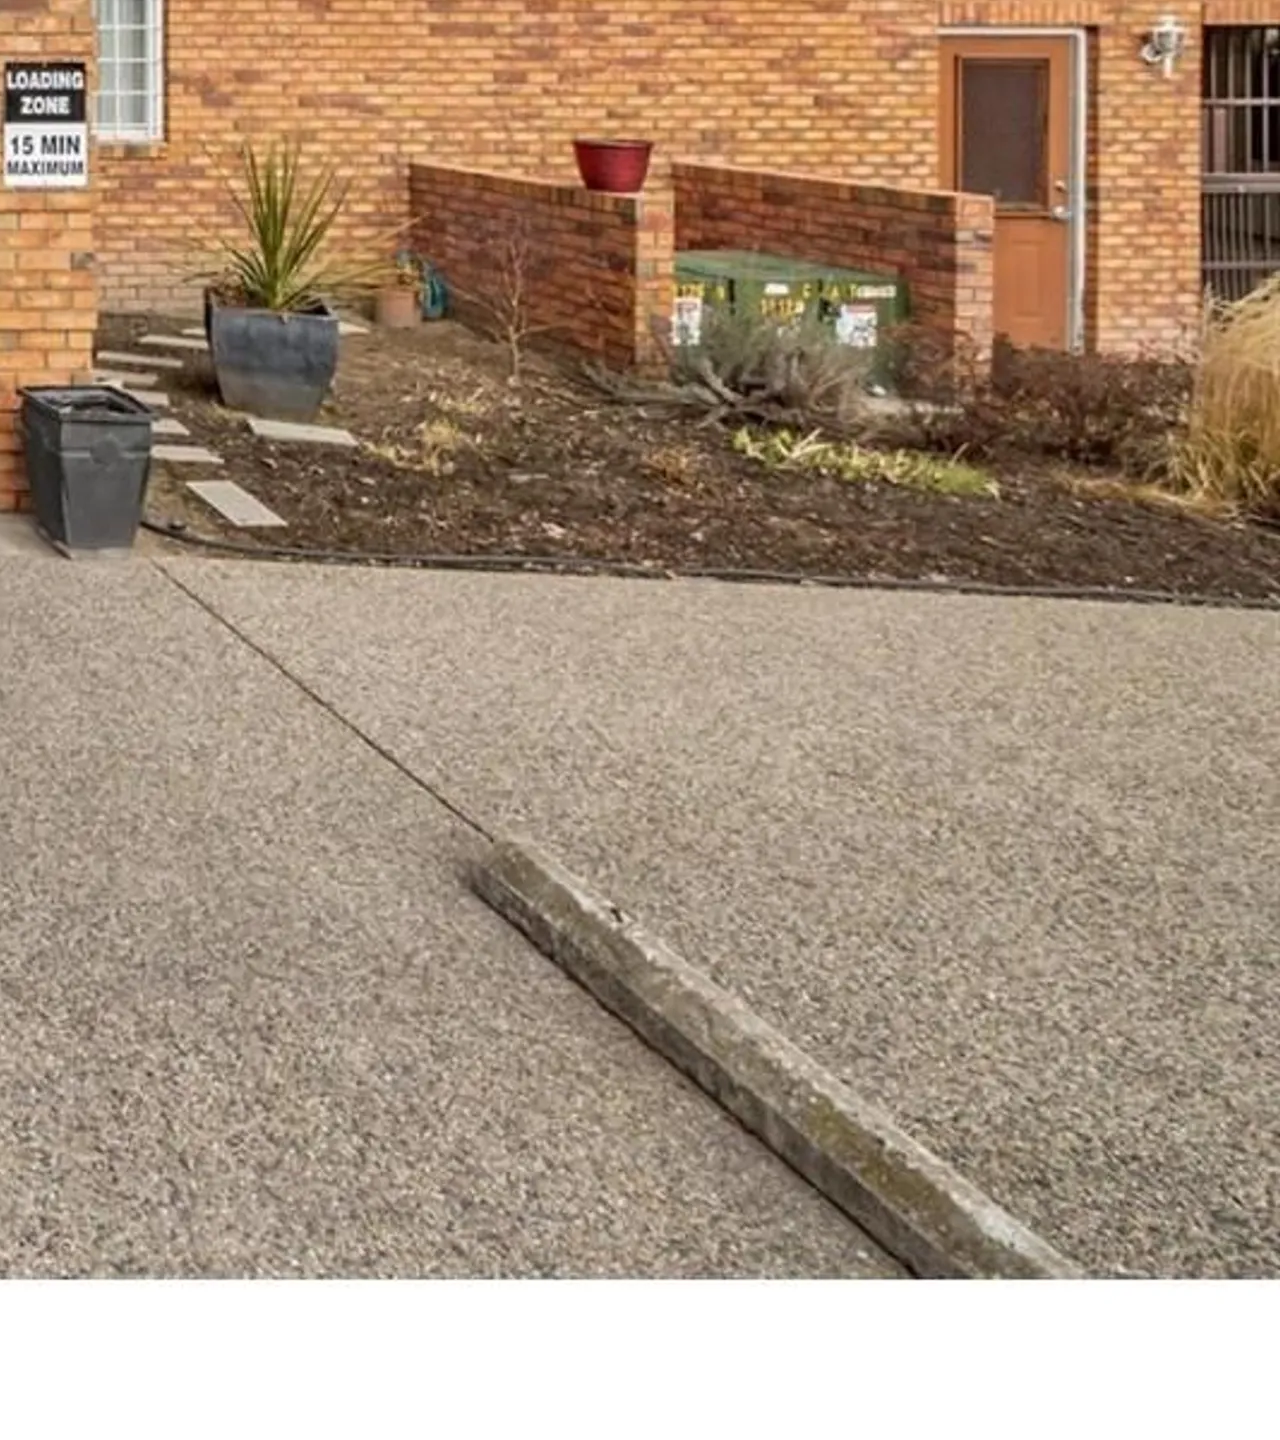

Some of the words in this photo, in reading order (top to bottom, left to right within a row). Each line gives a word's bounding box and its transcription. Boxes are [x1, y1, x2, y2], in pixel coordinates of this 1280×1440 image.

[7, 70, 84, 91] LOADING
[20, 95, 70, 115] ZONE
[11, 134, 34, 156] 15
[41, 134, 80, 155] MIN
[7, 160, 84, 176] MAXIMUM
